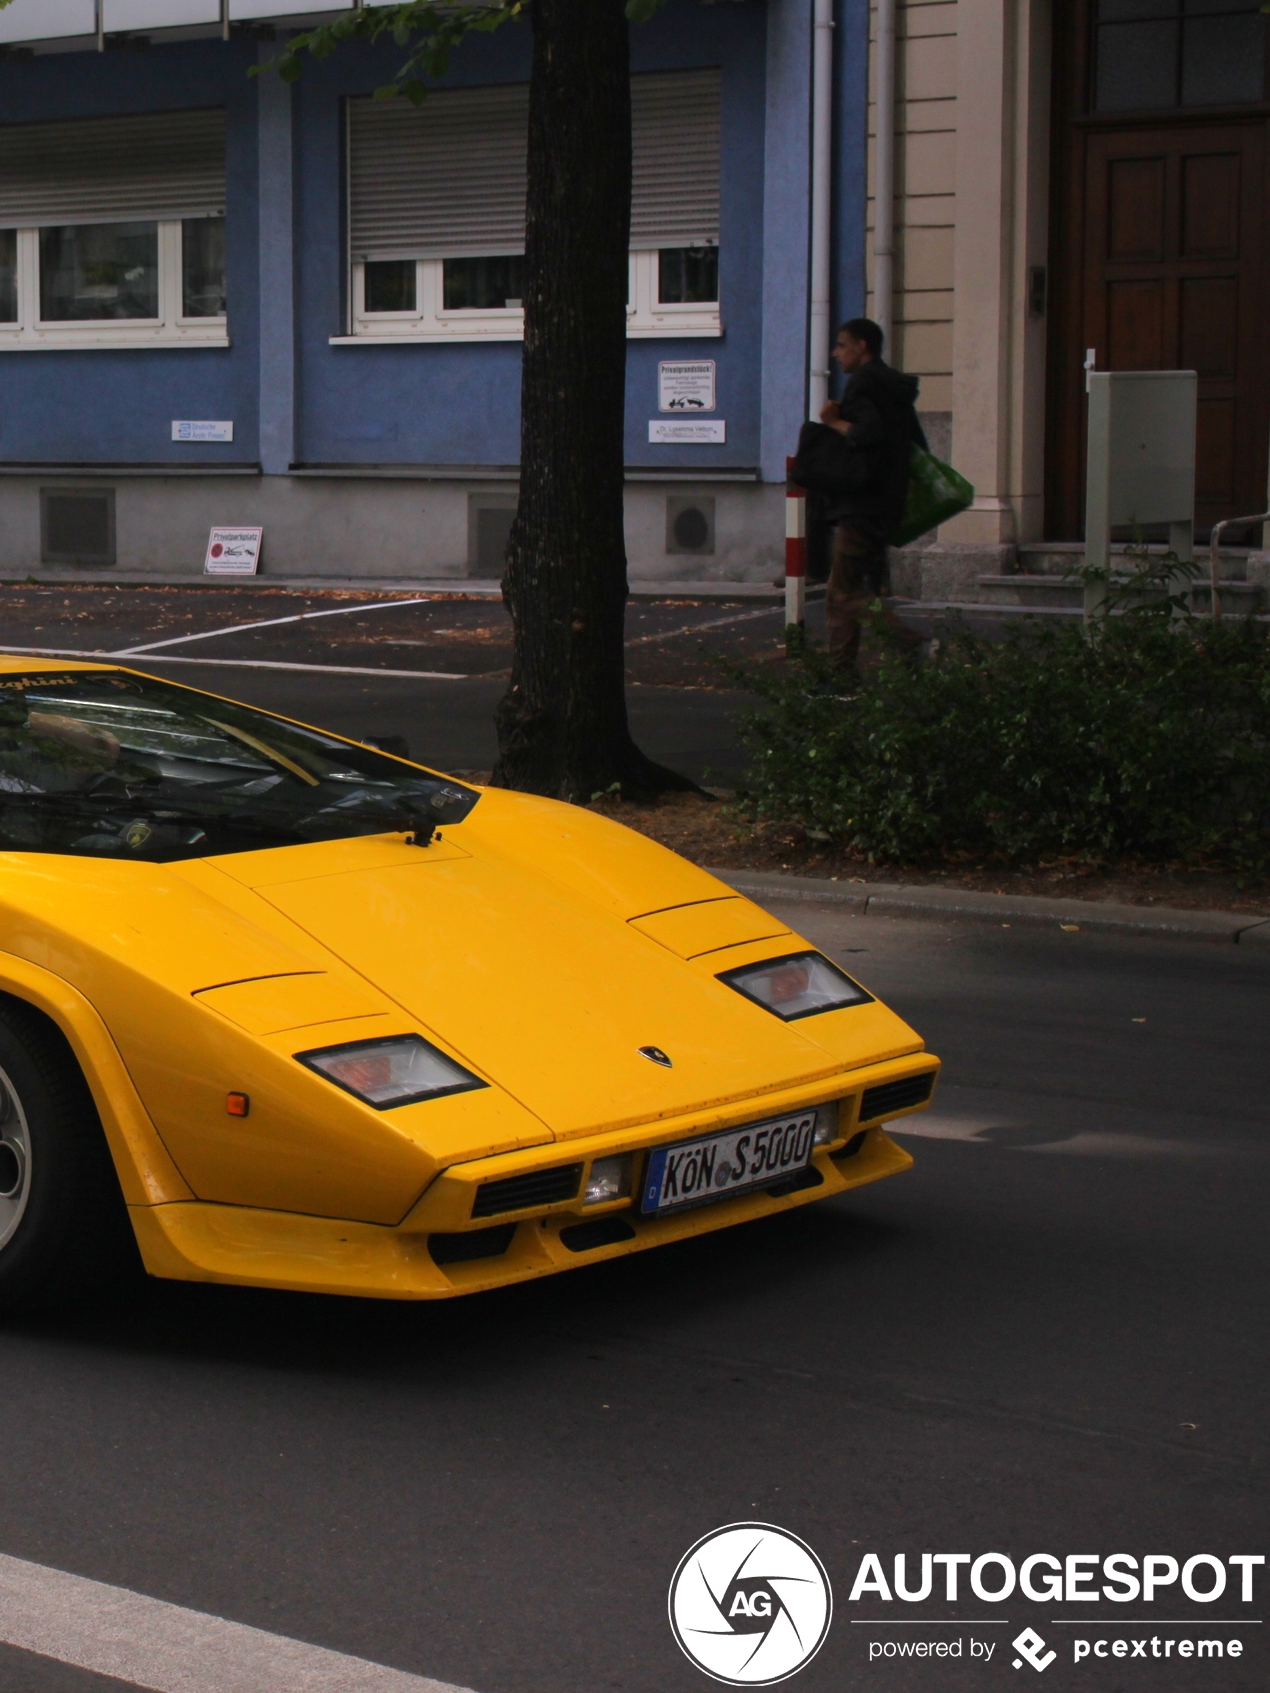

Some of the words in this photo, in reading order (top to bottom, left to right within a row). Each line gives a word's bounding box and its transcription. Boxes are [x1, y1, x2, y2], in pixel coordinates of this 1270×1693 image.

[213, 533, 258, 541] Privatparkplatz
[663, 1144, 717, 1200] KÖN
[648, 1186, 656, 1200] D
